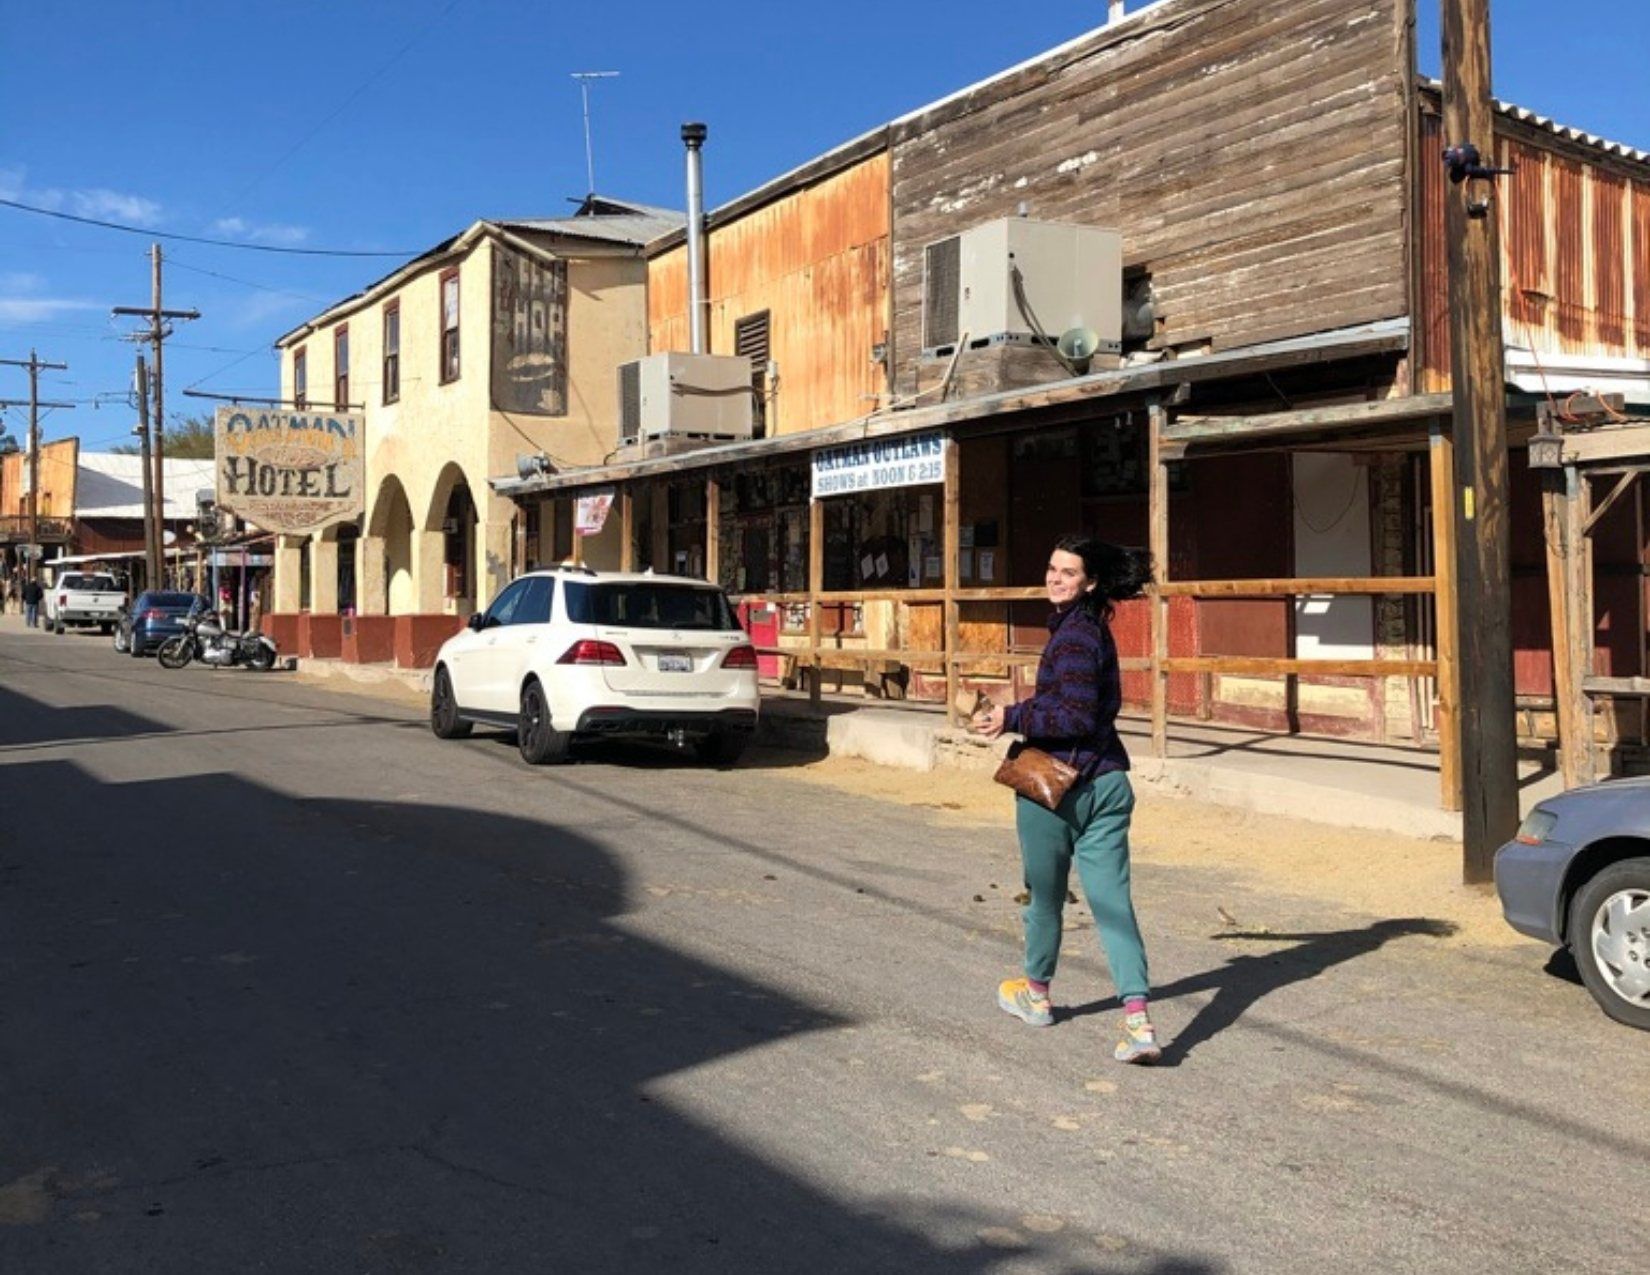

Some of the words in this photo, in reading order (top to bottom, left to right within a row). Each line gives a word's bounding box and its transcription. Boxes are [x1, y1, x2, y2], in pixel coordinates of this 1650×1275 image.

[226, 413, 357, 464] OATMAN
[873, 433, 941, 463] OUTLAWS
[223, 456, 351, 498] HOTEL
[817, 473, 856, 493] SHOWS
[872, 466, 905, 485] NOON
